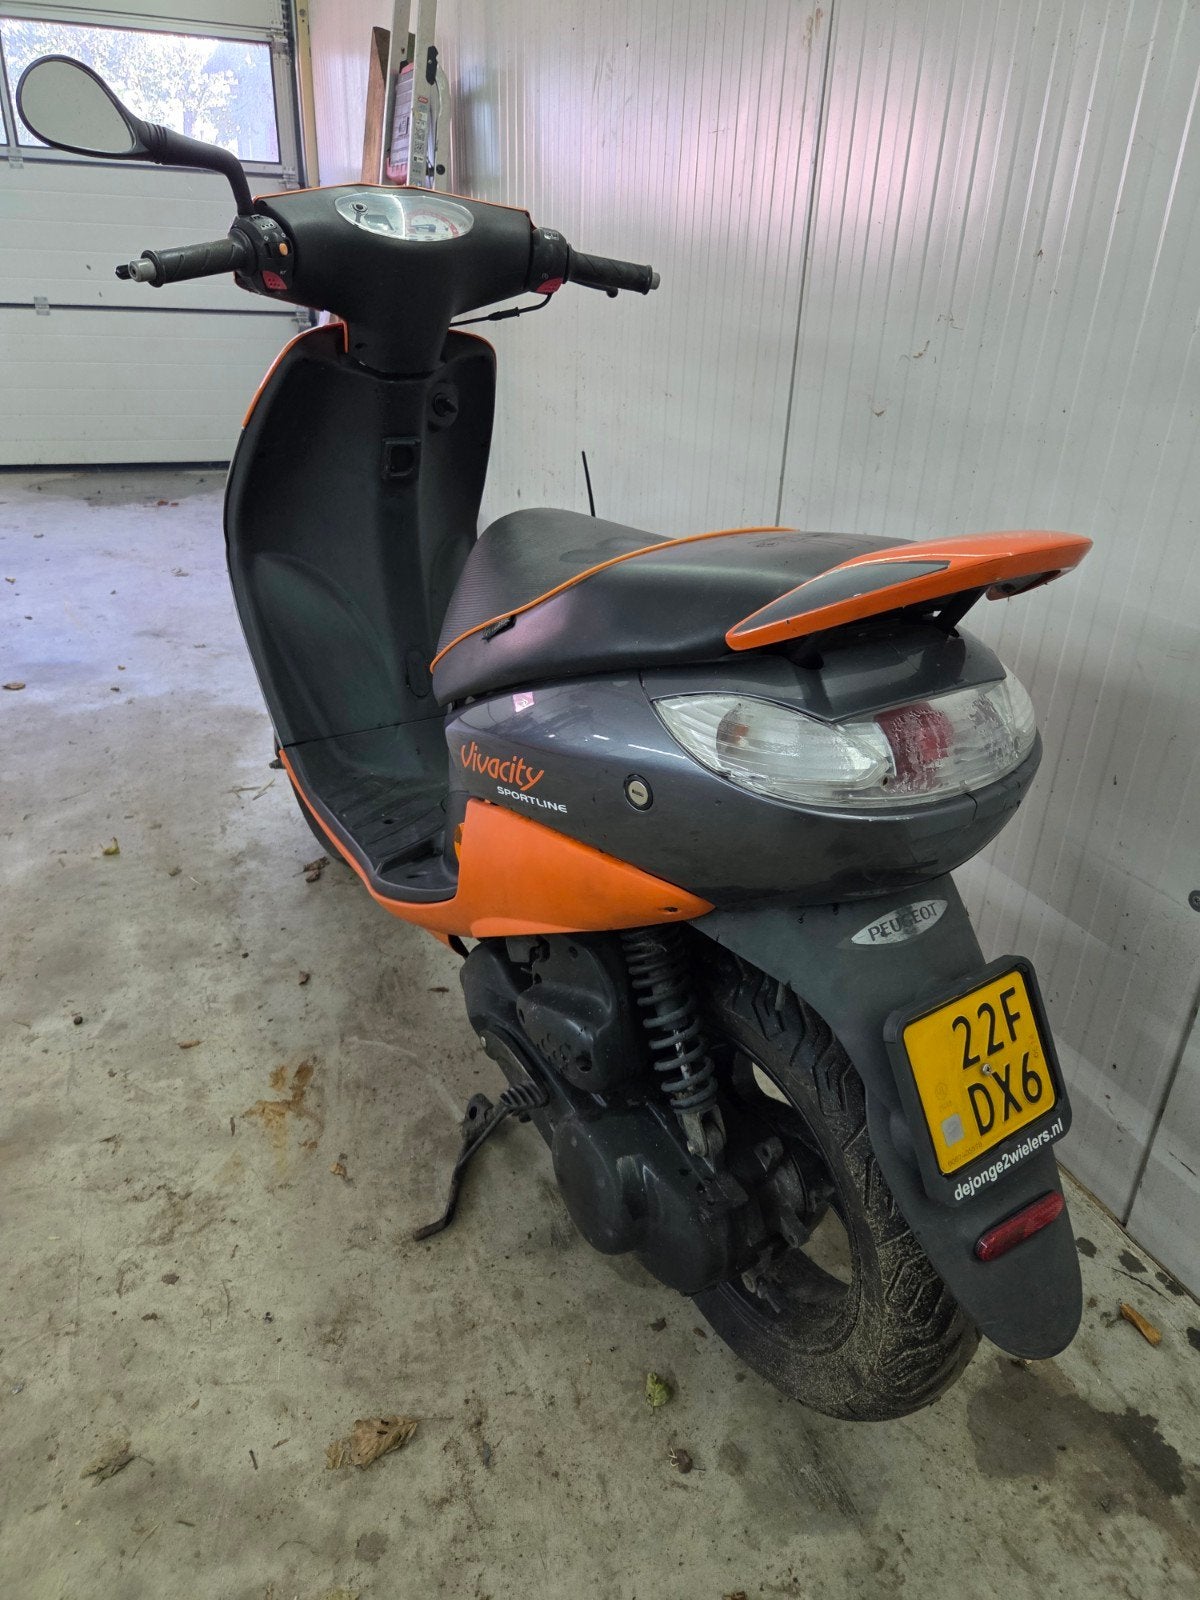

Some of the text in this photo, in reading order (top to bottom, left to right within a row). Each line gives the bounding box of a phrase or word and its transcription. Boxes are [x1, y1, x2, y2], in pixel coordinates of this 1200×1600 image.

[461, 741, 544, 791] Vivacity
[497, 786, 567, 813] SPORTLINE
[867, 903, 938, 941] PEUGEOT
[952, 987, 1021, 1070] 22F
[967, 1052, 1043, 1137] DX6
[954, 1118, 1064, 1201] dejonge2wielers.nl
